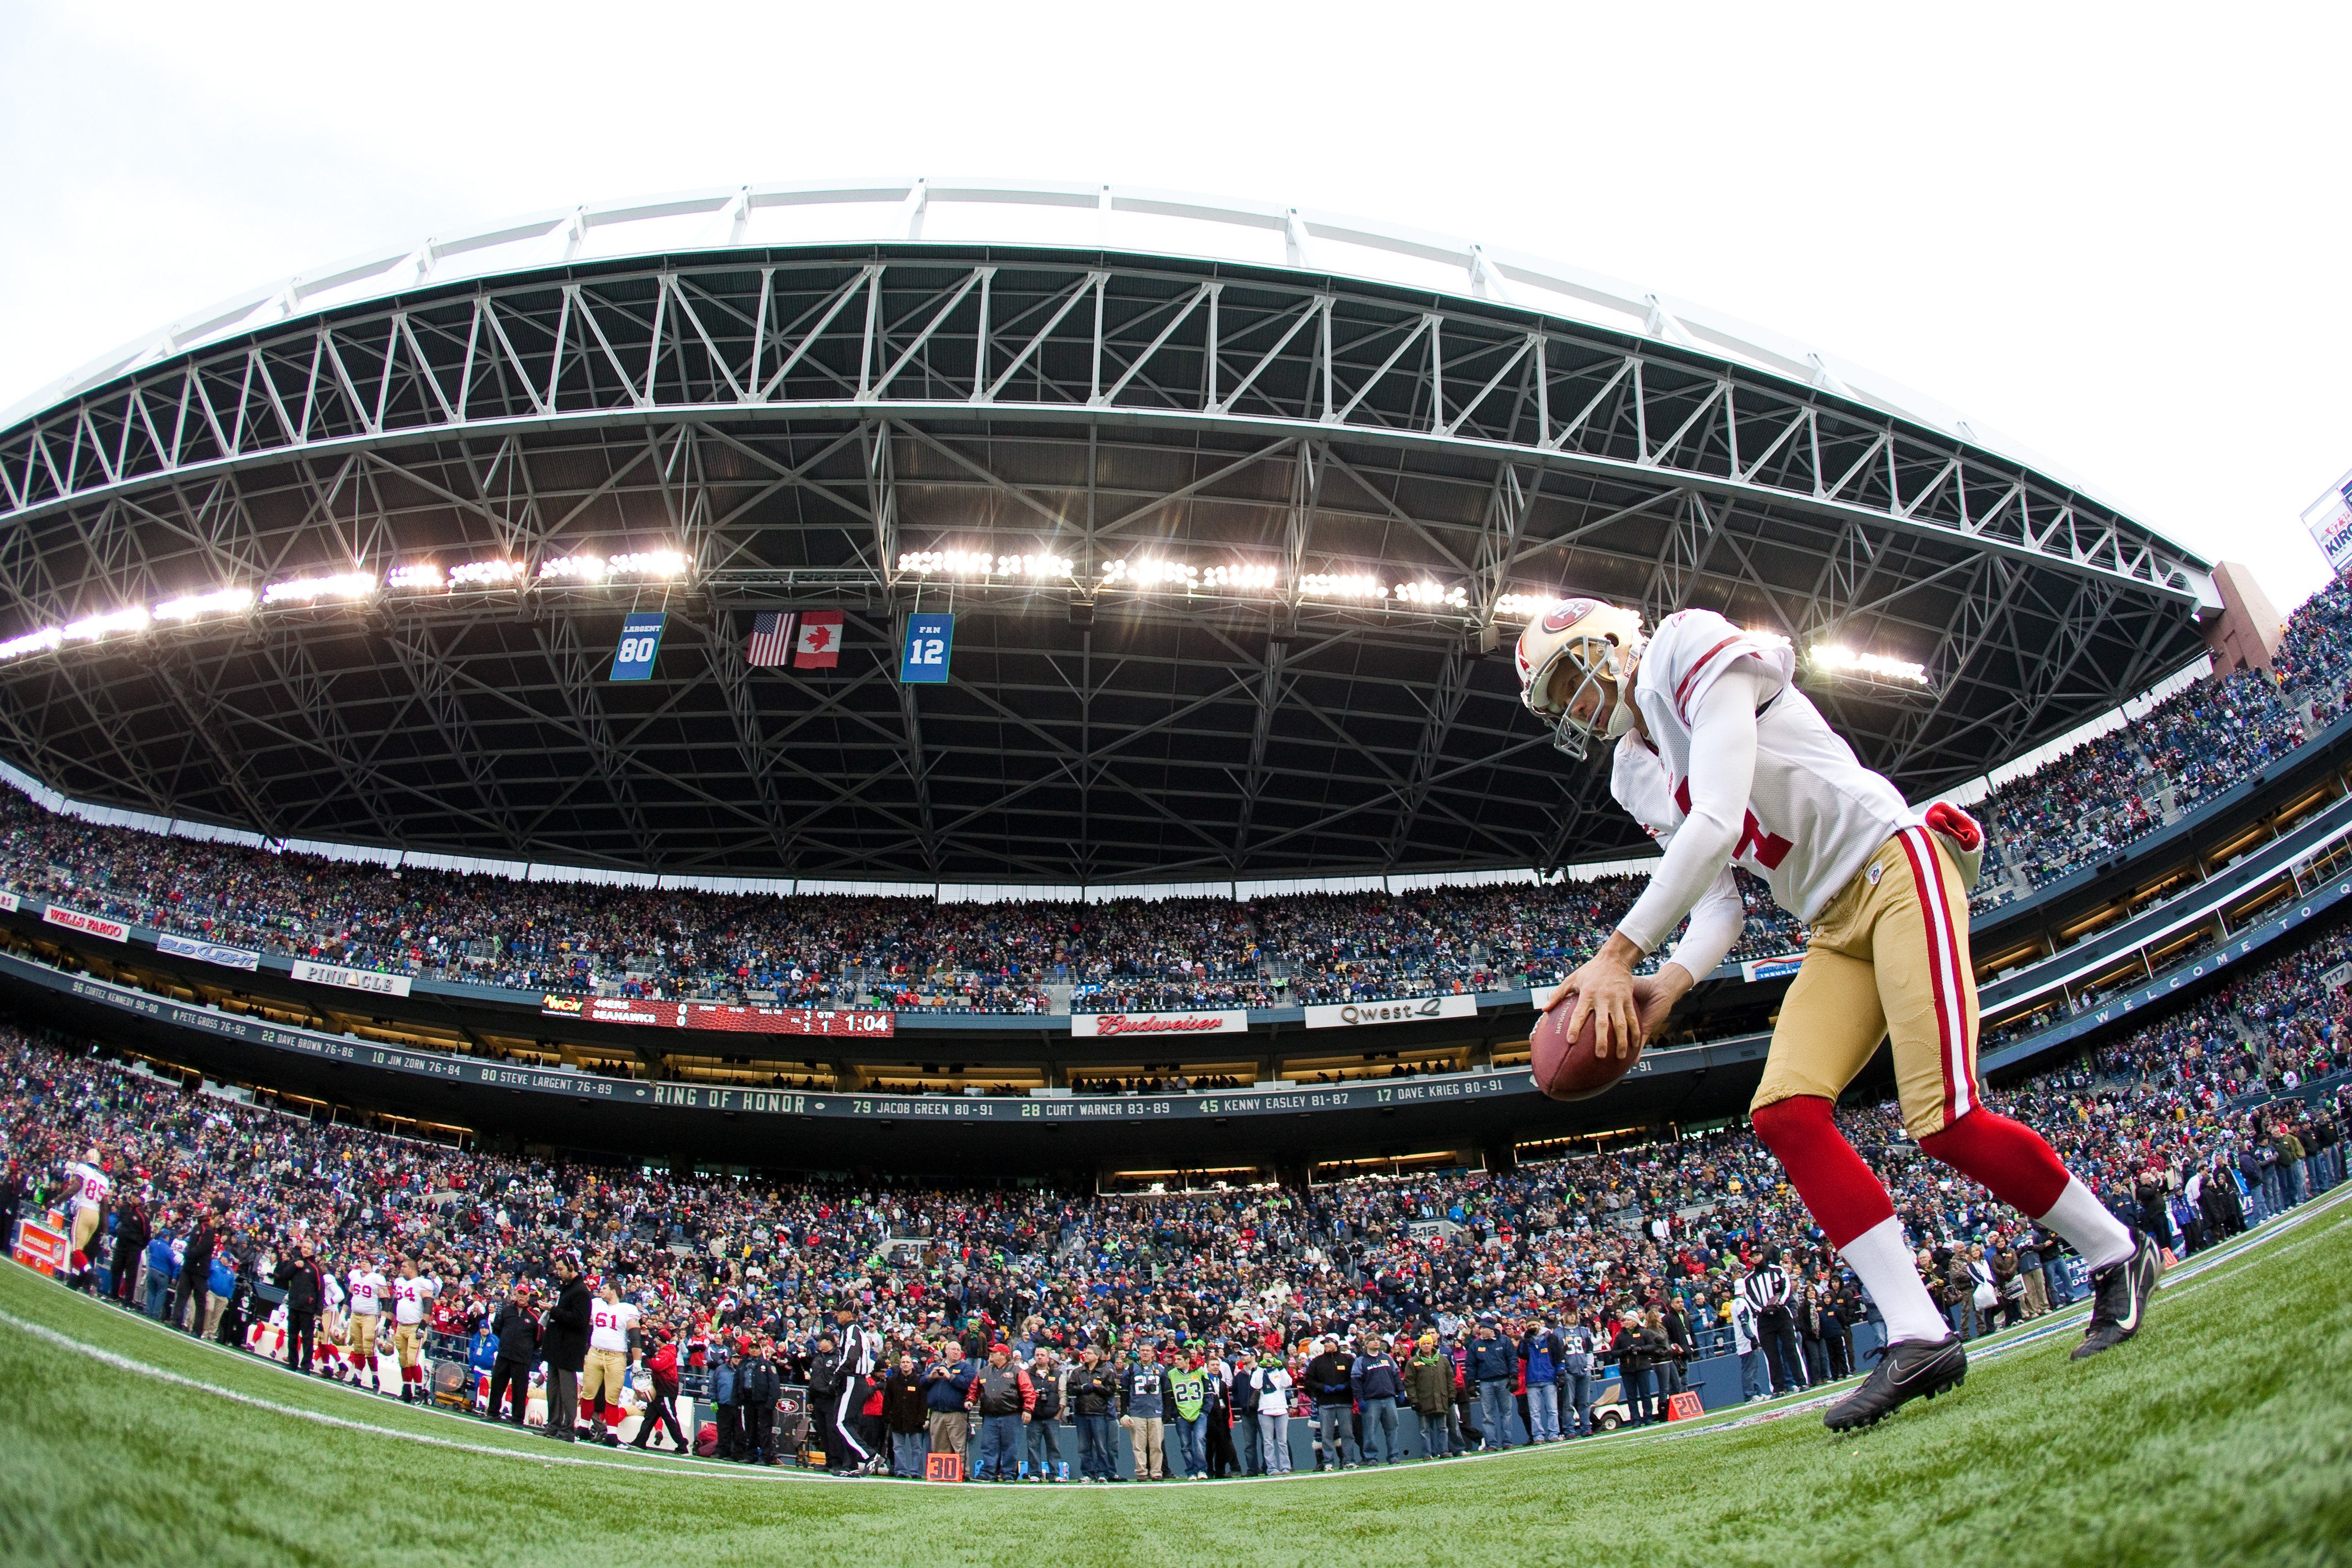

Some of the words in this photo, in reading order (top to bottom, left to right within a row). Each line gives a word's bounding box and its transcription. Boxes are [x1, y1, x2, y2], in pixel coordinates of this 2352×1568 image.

[618, 638, 655, 662] 80
[910, 639, 944, 664] 12
[1624, 654, 1635, 679] Riddell
[51, 909, 85, 928] WELLS
[87, 919, 122, 937] FARGO
[2278, 906, 2311, 929] TO
[158, 938, 195, 954] BUD
[203, 946, 258, 966] LIGHT
[2325, 967, 2345, 984] 117
[72, 982, 83, 993] 96
[84, 986, 106, 999] CORTEZ
[107, 992, 134, 1007] KENNEDY
[135, 1000, 159, 1013] 90-00
[593, 999, 630, 1010] 49ERS
[677, 1004, 687, 1015] 0
[804, 1010, 812, 1020] 3
[817, 1011, 835, 1019] QTR
[1341, 1005, 1411, 1024] Qwest
[1555, 1005, 1569, 1034] NATIONAL
[179, 1011, 196, 1023] PETE
[197, 1017, 218, 1029] GROSS
[220, 1020, 246, 1035] 76-92
[592, 1010, 656, 1023] SEAHAWKS
[676, 1015, 687, 1027] 0
[803, 1022, 810, 1032] 3
[821, 1021, 828, 1032] 1
[845, 1014, 888, 1032] 1:04
[1097, 1014, 1223, 1035] Budweiser
[261, 1030, 274, 1043] 22
[277, 1034, 295, 1046] DAVE
[298, 1039, 322, 1052] BROWN
[325, 1043, 354, 1056] 76-86
[372, 1051, 385, 1064] 10
[388, 1055, 402, 1066] JIM
[403, 1058, 425, 1070] ZORN
[429, 1062, 460, 1076] 76-84
[481, 1068, 497, 1081] 80
[500, 1071, 528, 1085] STEVE
[532, 1075, 572, 1090] LARGENT
[577, 1081, 612, 1094] 76-89
[1377, 1089, 1391, 1102] 17
[1398, 1087, 1424, 1100] DAVE
[1428, 1083, 1459, 1097] KRIEG
[1465, 1080, 1503, 1093] 80-91
[654, 1087, 697, 1105] RING
[709, 1090, 731, 1108] OF
[743, 1092, 805, 1113] HONOR
[853, 1101, 871, 1114] 79
[877, 1102, 910, 1114] JACOB
[915, 1103, 949, 1115] GREEN
[1021, 1104, 1040, 1116] 28
[1046, 1104, 1074, 1116] CURT
[1080, 1103, 1122, 1115] WARNER
[1128, 1102, 1170, 1114] 83-89
[1200, 1100, 1218, 1113] 45
[1224, 1098, 1260, 1111] KENNY
[1266, 1096, 1305, 1109] EASLEY
[1311, 1093, 1348, 1106] 81-87
[85, 1179, 107, 1204] 85
[1409, 1226, 1439, 1238] 212
[353, 1284, 372, 1298] 69
[439, 1310, 449, 1322] 21
[595, 1312, 617, 1331] 61
[1565, 1336, 1584, 1355] 59
[1175, 1381, 1202, 1402] 23
[1675, 1395, 1699, 1416] 20
[930, 1457, 957, 1479] 30
